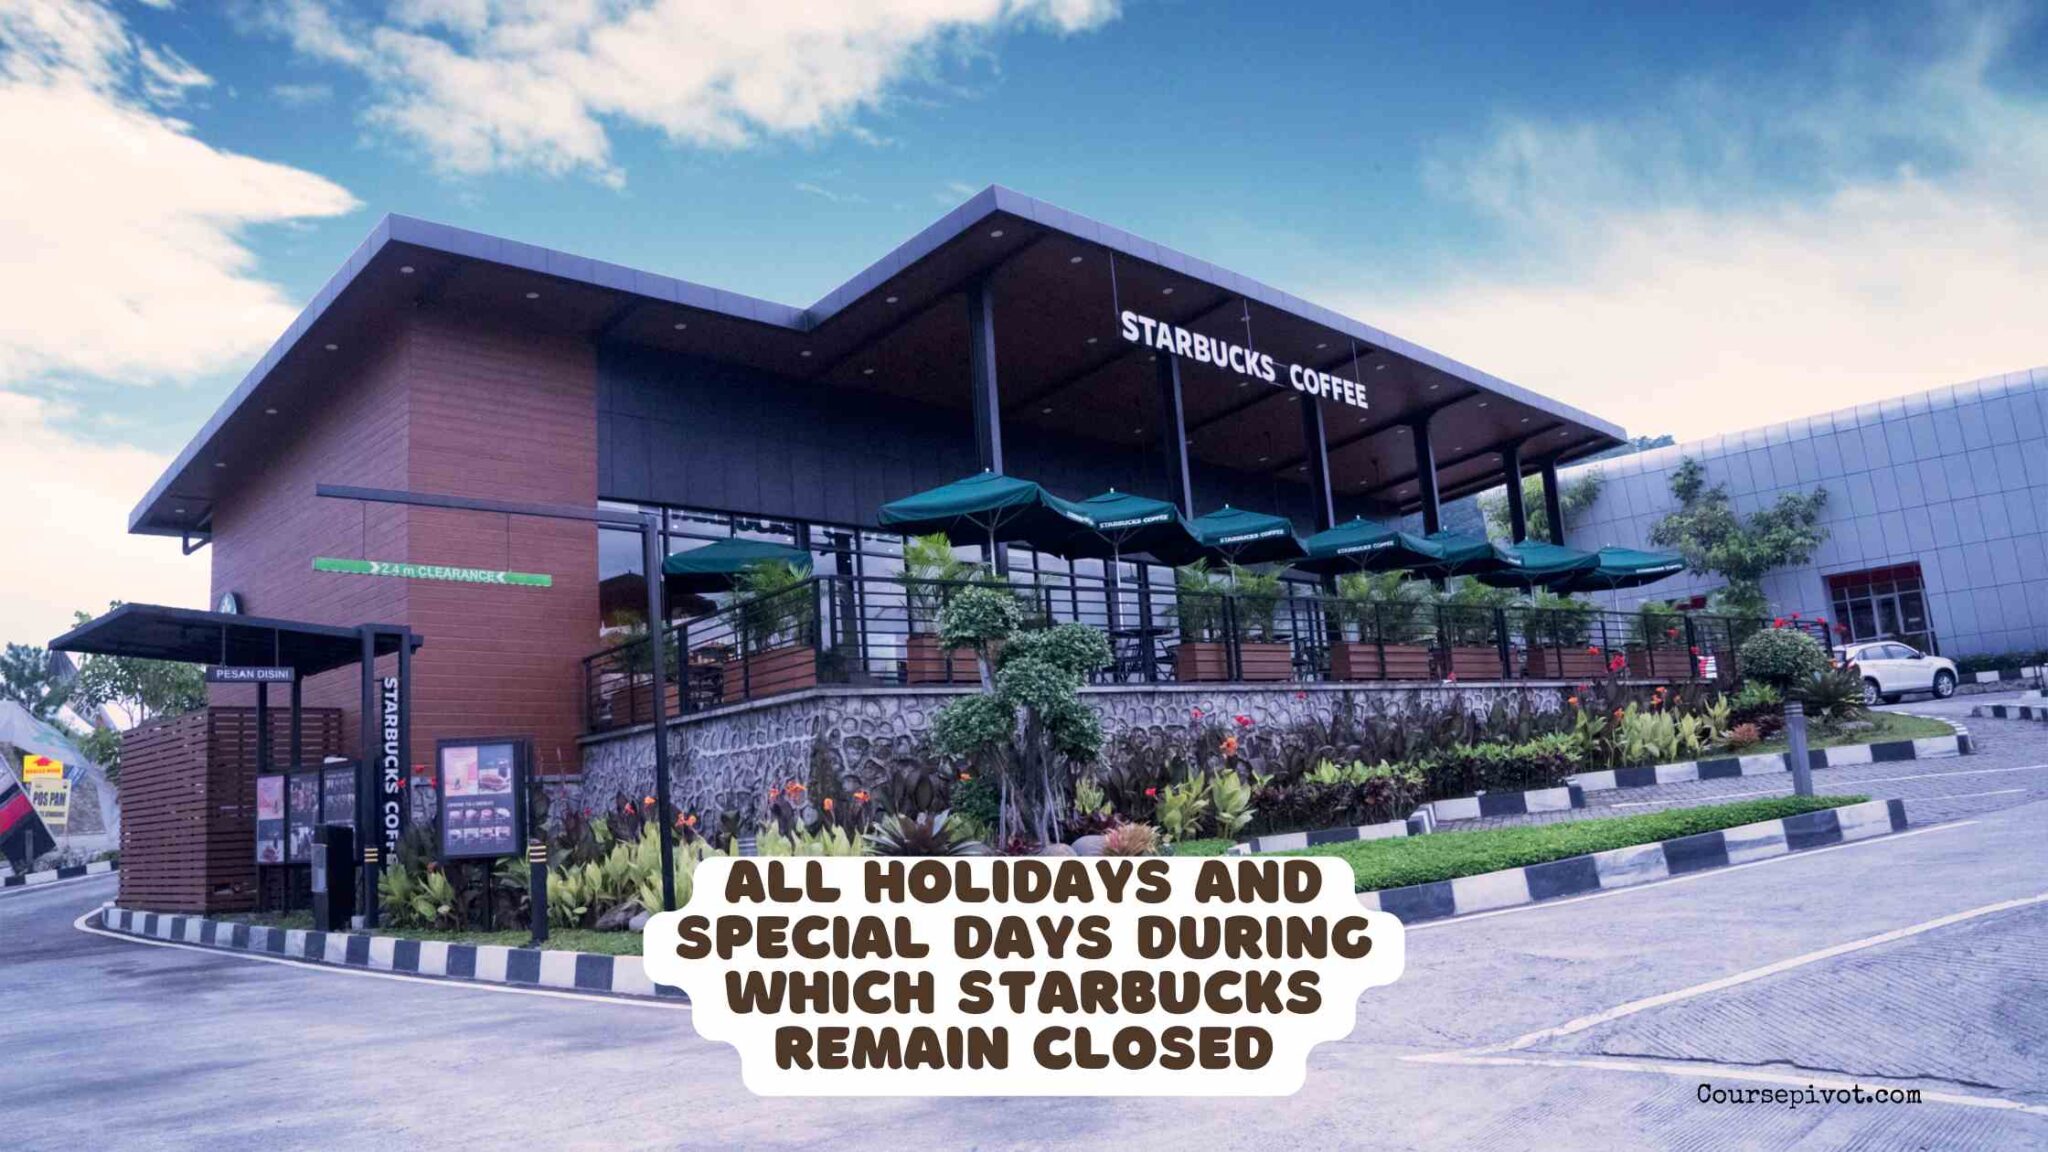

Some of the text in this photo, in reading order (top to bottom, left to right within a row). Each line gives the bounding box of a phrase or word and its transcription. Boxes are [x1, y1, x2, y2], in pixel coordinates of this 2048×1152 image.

[1121, 310, 1368, 409] STARBUCKS COFFEE
[380, 562, 496, 583] 2.4 m CLEARANCE
[216, 669, 289, 679] PESAN DISINI
[384, 677, 399, 794] STARBUCKS
